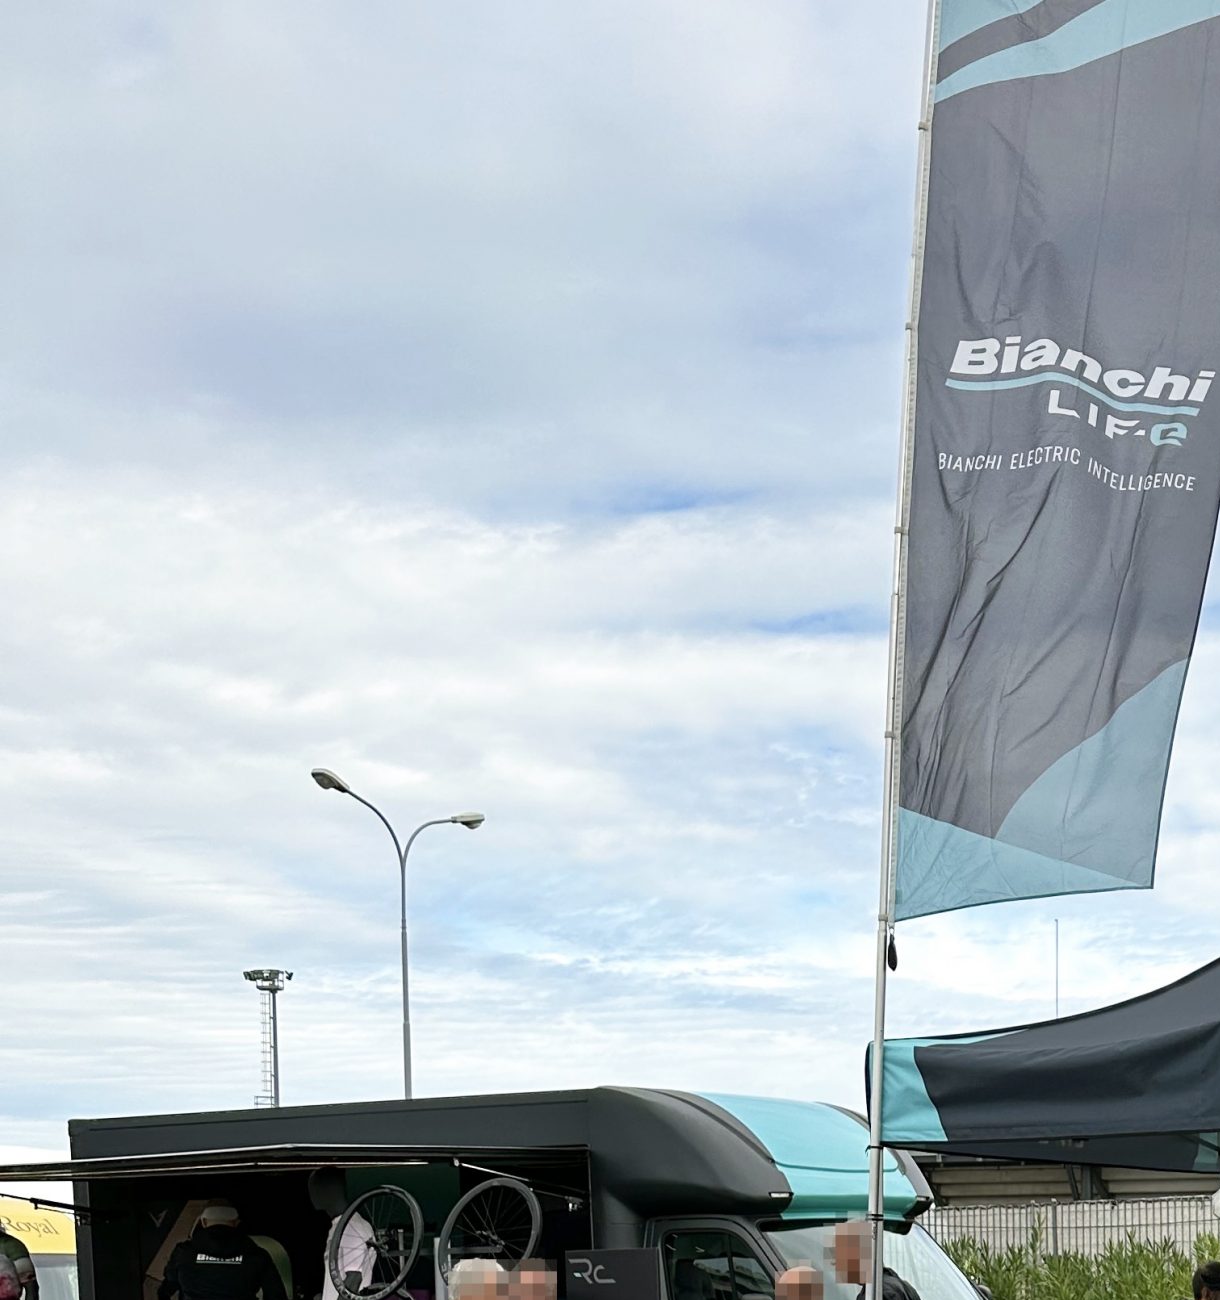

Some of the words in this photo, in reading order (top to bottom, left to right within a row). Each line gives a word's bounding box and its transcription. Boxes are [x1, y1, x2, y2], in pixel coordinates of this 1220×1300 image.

[950, 336, 1215, 402] Bianchi
[938, 453, 1002, 472] BIANCHI
[1010, 446, 1081, 470] ELECTRIC
[1088, 458, 1196, 491] INTELLIGENCE
